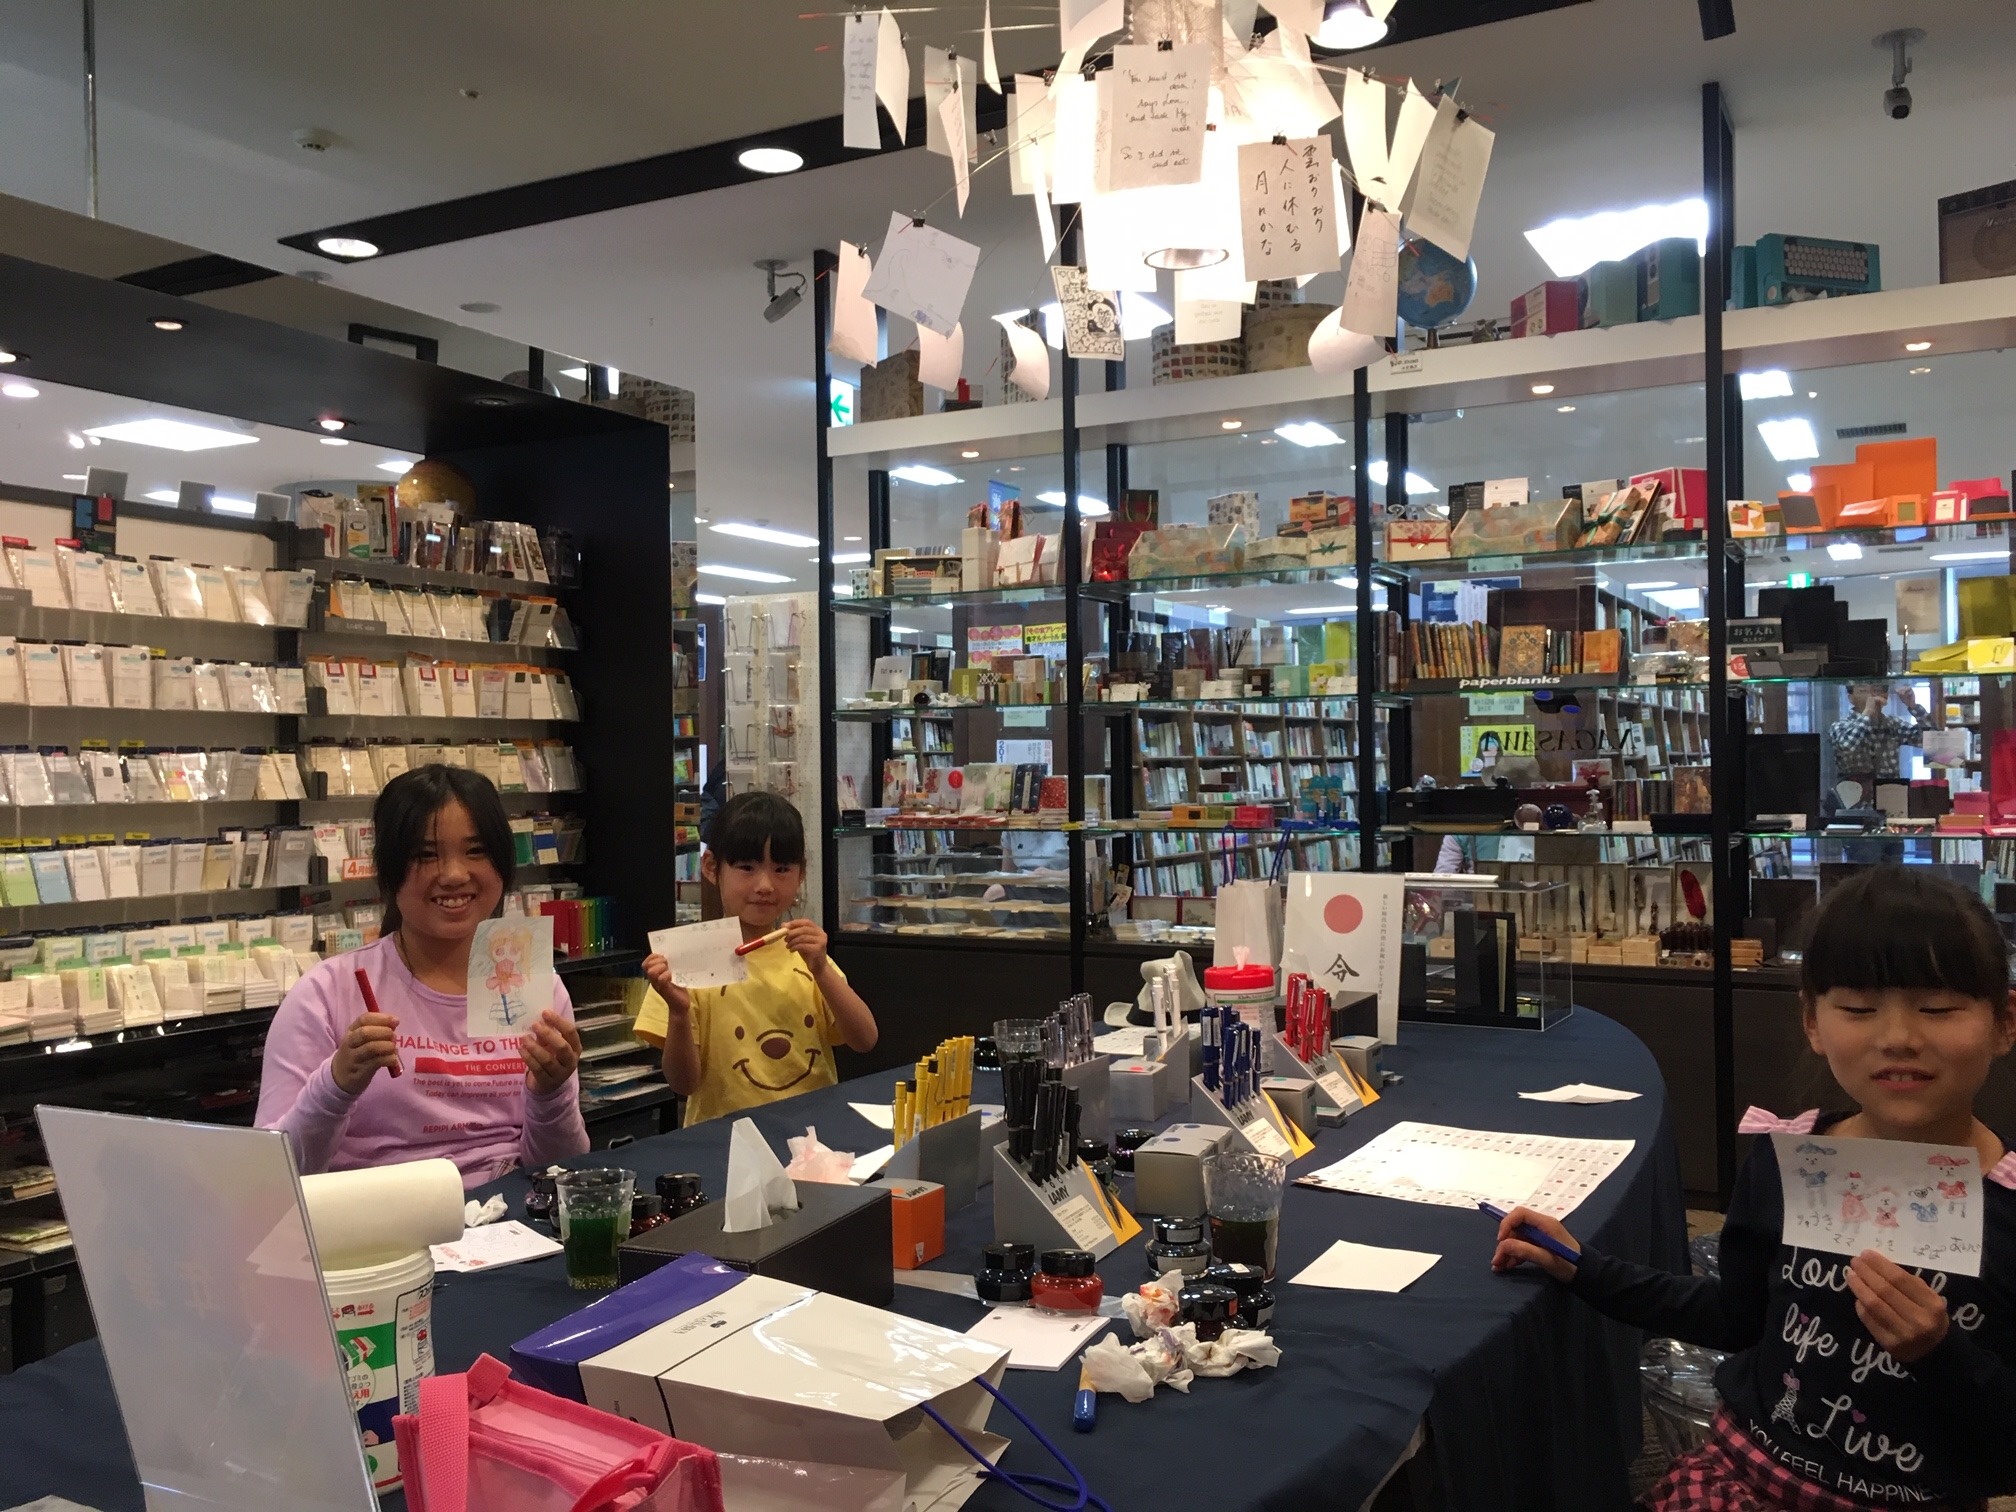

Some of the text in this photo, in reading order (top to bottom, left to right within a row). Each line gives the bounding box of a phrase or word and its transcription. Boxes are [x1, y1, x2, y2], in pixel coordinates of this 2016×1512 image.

[1148, 150, 1164, 159] did
[1151, 158, 1169, 169] and
[1459, 675, 1562, 689] paperblanks
[1323, 953, 1361, 983] 令
[396, 1035, 470, 1056] HALLENGE
[473, 1040, 496, 1055] TO
[465, 1064, 481, 1072] THE
[465, 1079, 472, 1087] to
[425, 1090, 445, 1098] Today
[1236, 1110, 1255, 1126] LAMY
[1047, 1185, 1070, 1206] LAMY
[1781, 1246, 1851, 1292] Lov
[1782, 1303, 1917, 1383] life yo
[1806, 1394, 1925, 1472] Live
[1780, 1451, 1831, 1485] FEEL
